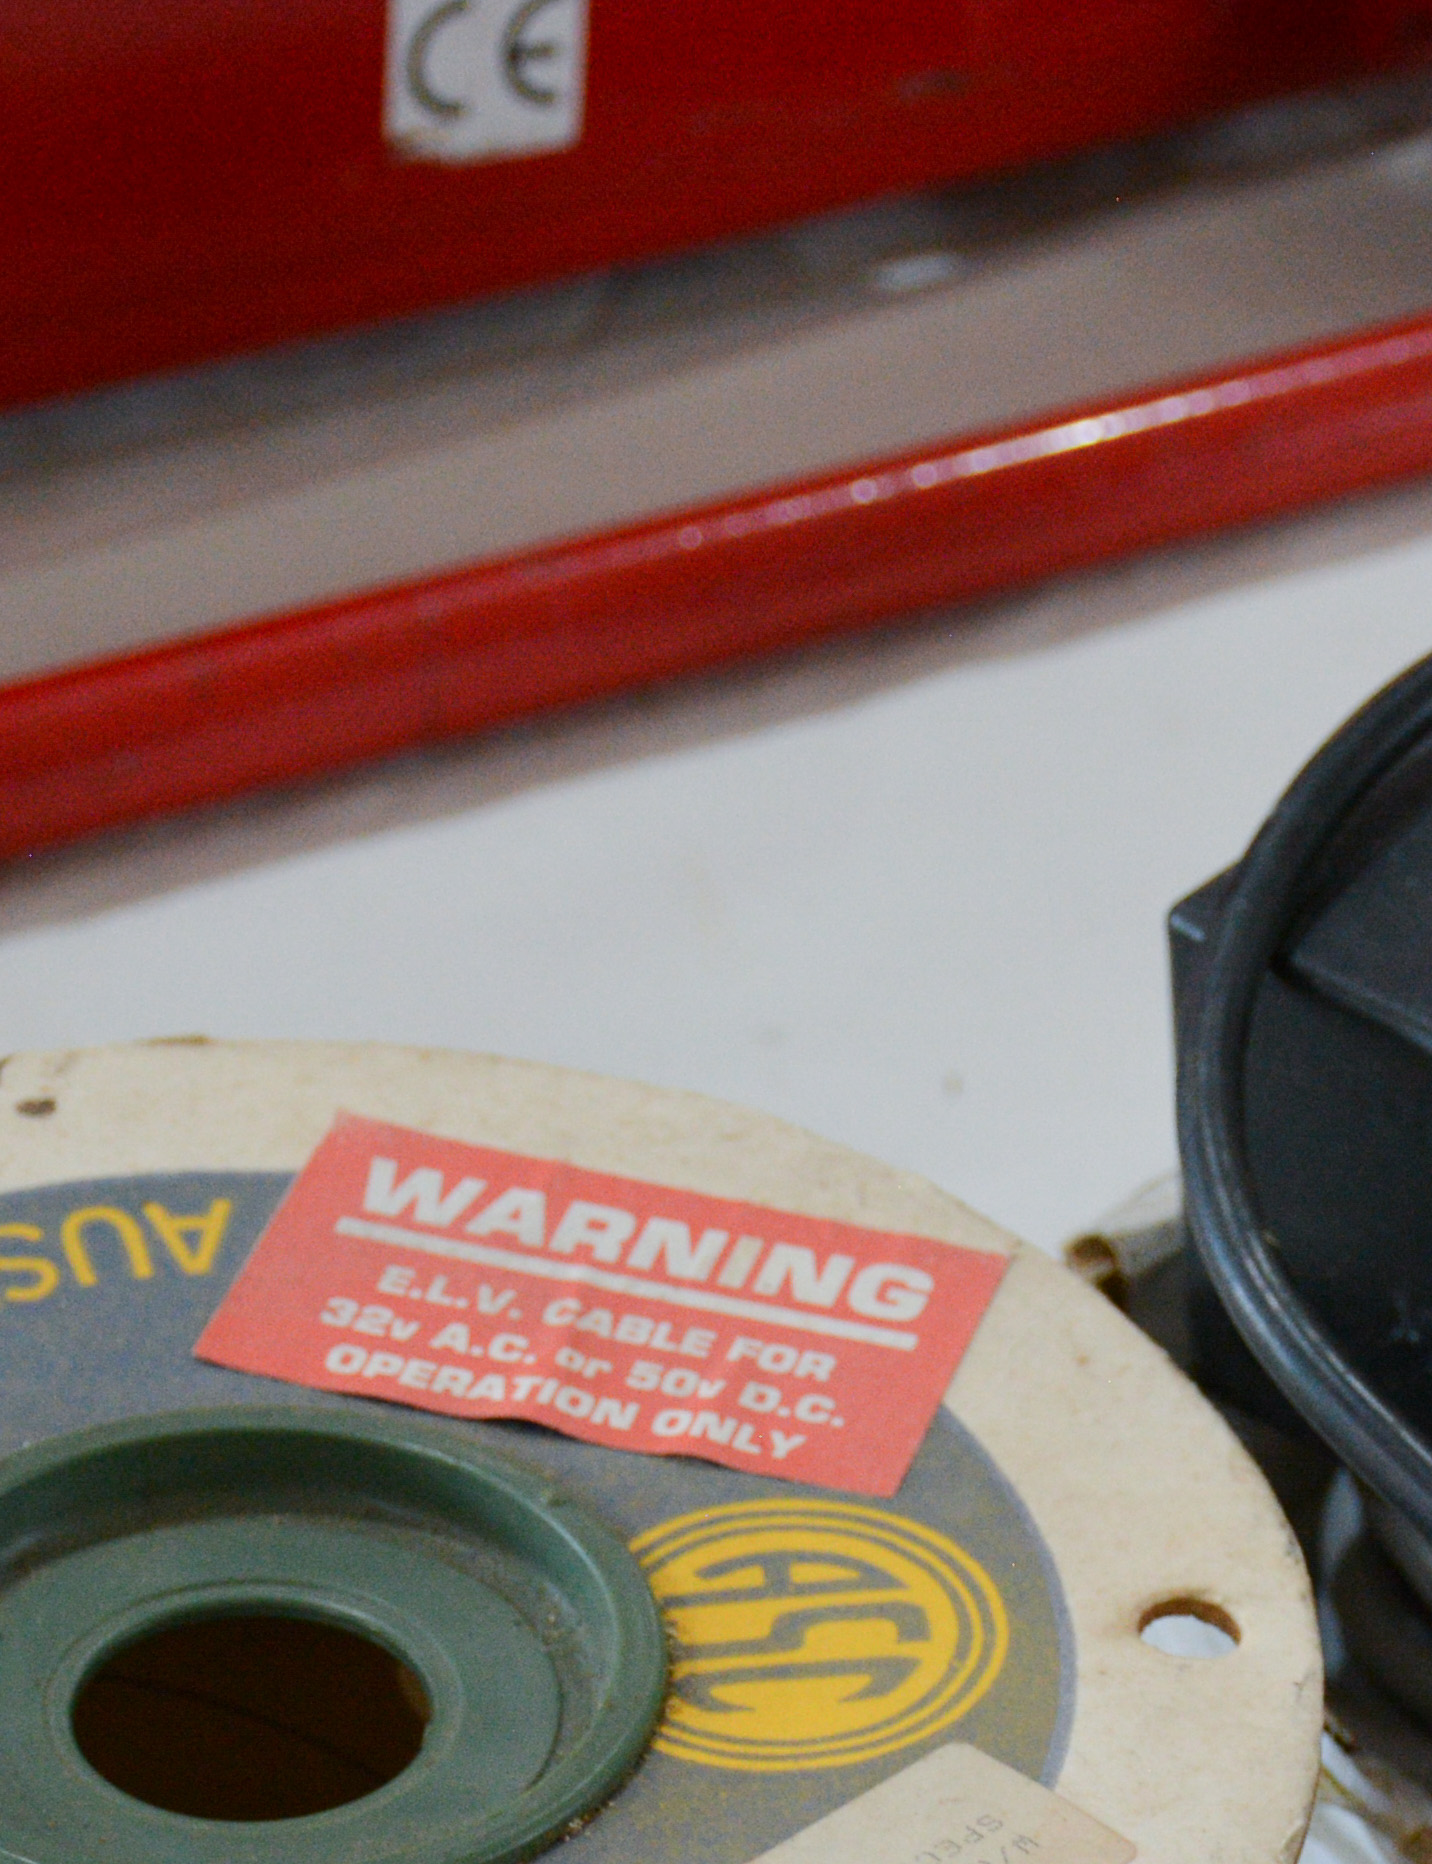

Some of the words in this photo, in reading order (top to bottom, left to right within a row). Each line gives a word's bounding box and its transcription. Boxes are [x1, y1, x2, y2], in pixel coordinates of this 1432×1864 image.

[406, 0, 558, 118] CE
[363, 1156, 934, 1321] WARNING
[378, 1265, 522, 1321] E.L.V.
[541, 1298, 717, 1358] CABLE
[728, 1338, 836, 1384] FOR
[430, 1321, 537, 1365] A.C.
[555, 1349, 611, 1375] or
[626, 1361, 722, 1400] 50v
[745, 1381, 845, 1428] D.C.
[325, 1345, 641, 1432] OPERATION
[651, 1409, 807, 1460] ONLY
